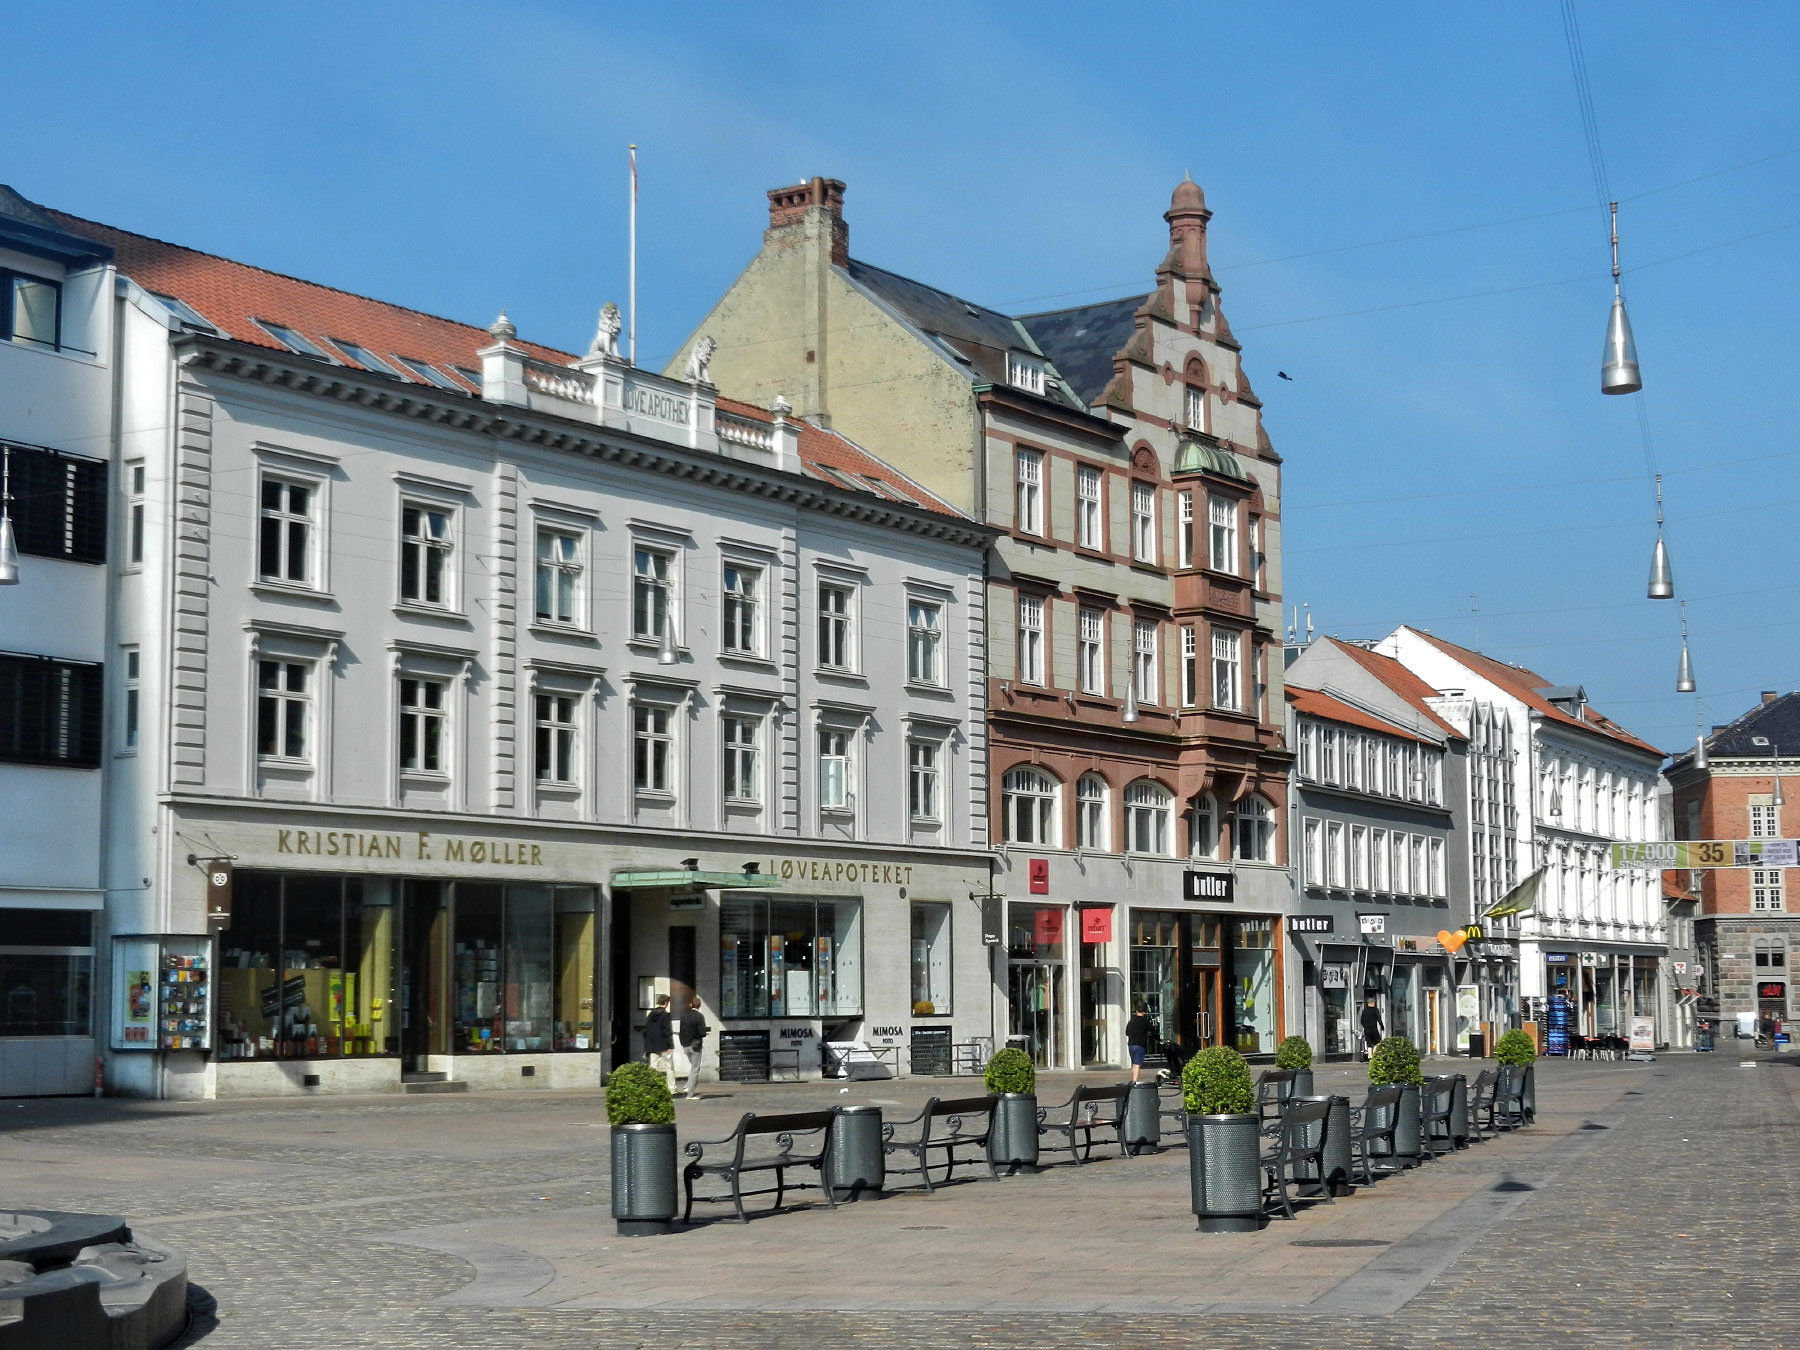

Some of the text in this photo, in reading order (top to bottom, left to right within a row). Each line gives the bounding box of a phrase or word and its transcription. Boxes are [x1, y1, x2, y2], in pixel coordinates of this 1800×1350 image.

[278, 828, 543, 866] KRISTIAN F. MØLLER
[1619, 843, 1677, 860] 17.000
[1699, 842, 1724, 863] 35
[770, 859, 913, 884] LØVEAPOTEKET
[1618, 859, 1677, 868] STUDERENDE
[1193, 875, 1227, 897] butler
[1292, 918, 1329, 931] butler
[780, 1028, 814, 1039] MIMOSA
[872, 1026, 903, 1037] MIMOSA
